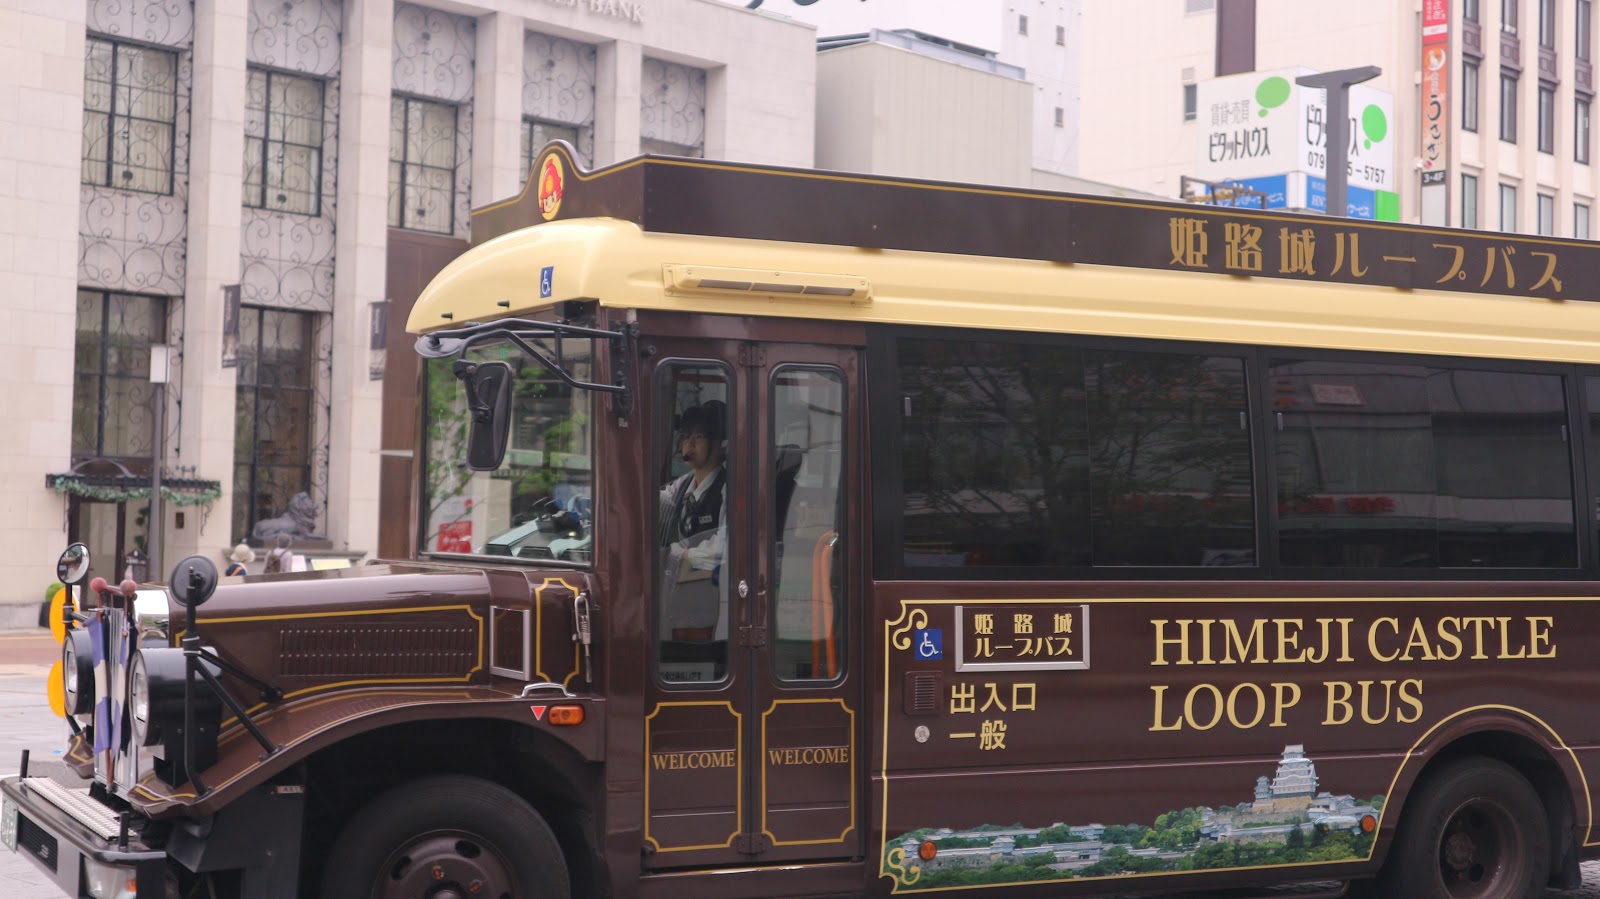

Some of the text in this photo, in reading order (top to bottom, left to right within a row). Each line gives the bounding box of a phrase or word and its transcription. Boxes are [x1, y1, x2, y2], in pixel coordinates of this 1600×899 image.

[1209, 127, 1271, 162] ピタットハウス
[1169, 217, 1563, 293] 姫路城ループバス
[974, 613, 1073, 635] 姫路城
[974, 637, 1073, 659] ループバス
[1150, 616, 1558, 665] HIMEJI CASTLE
[950, 683, 1036, 714] 出入口
[1148, 679, 1424, 732] LOOP BUS
[949, 720, 1007, 751] 一般
[652, 752, 736, 770] WELCOME
[768, 748, 849, 766] WELCOME
